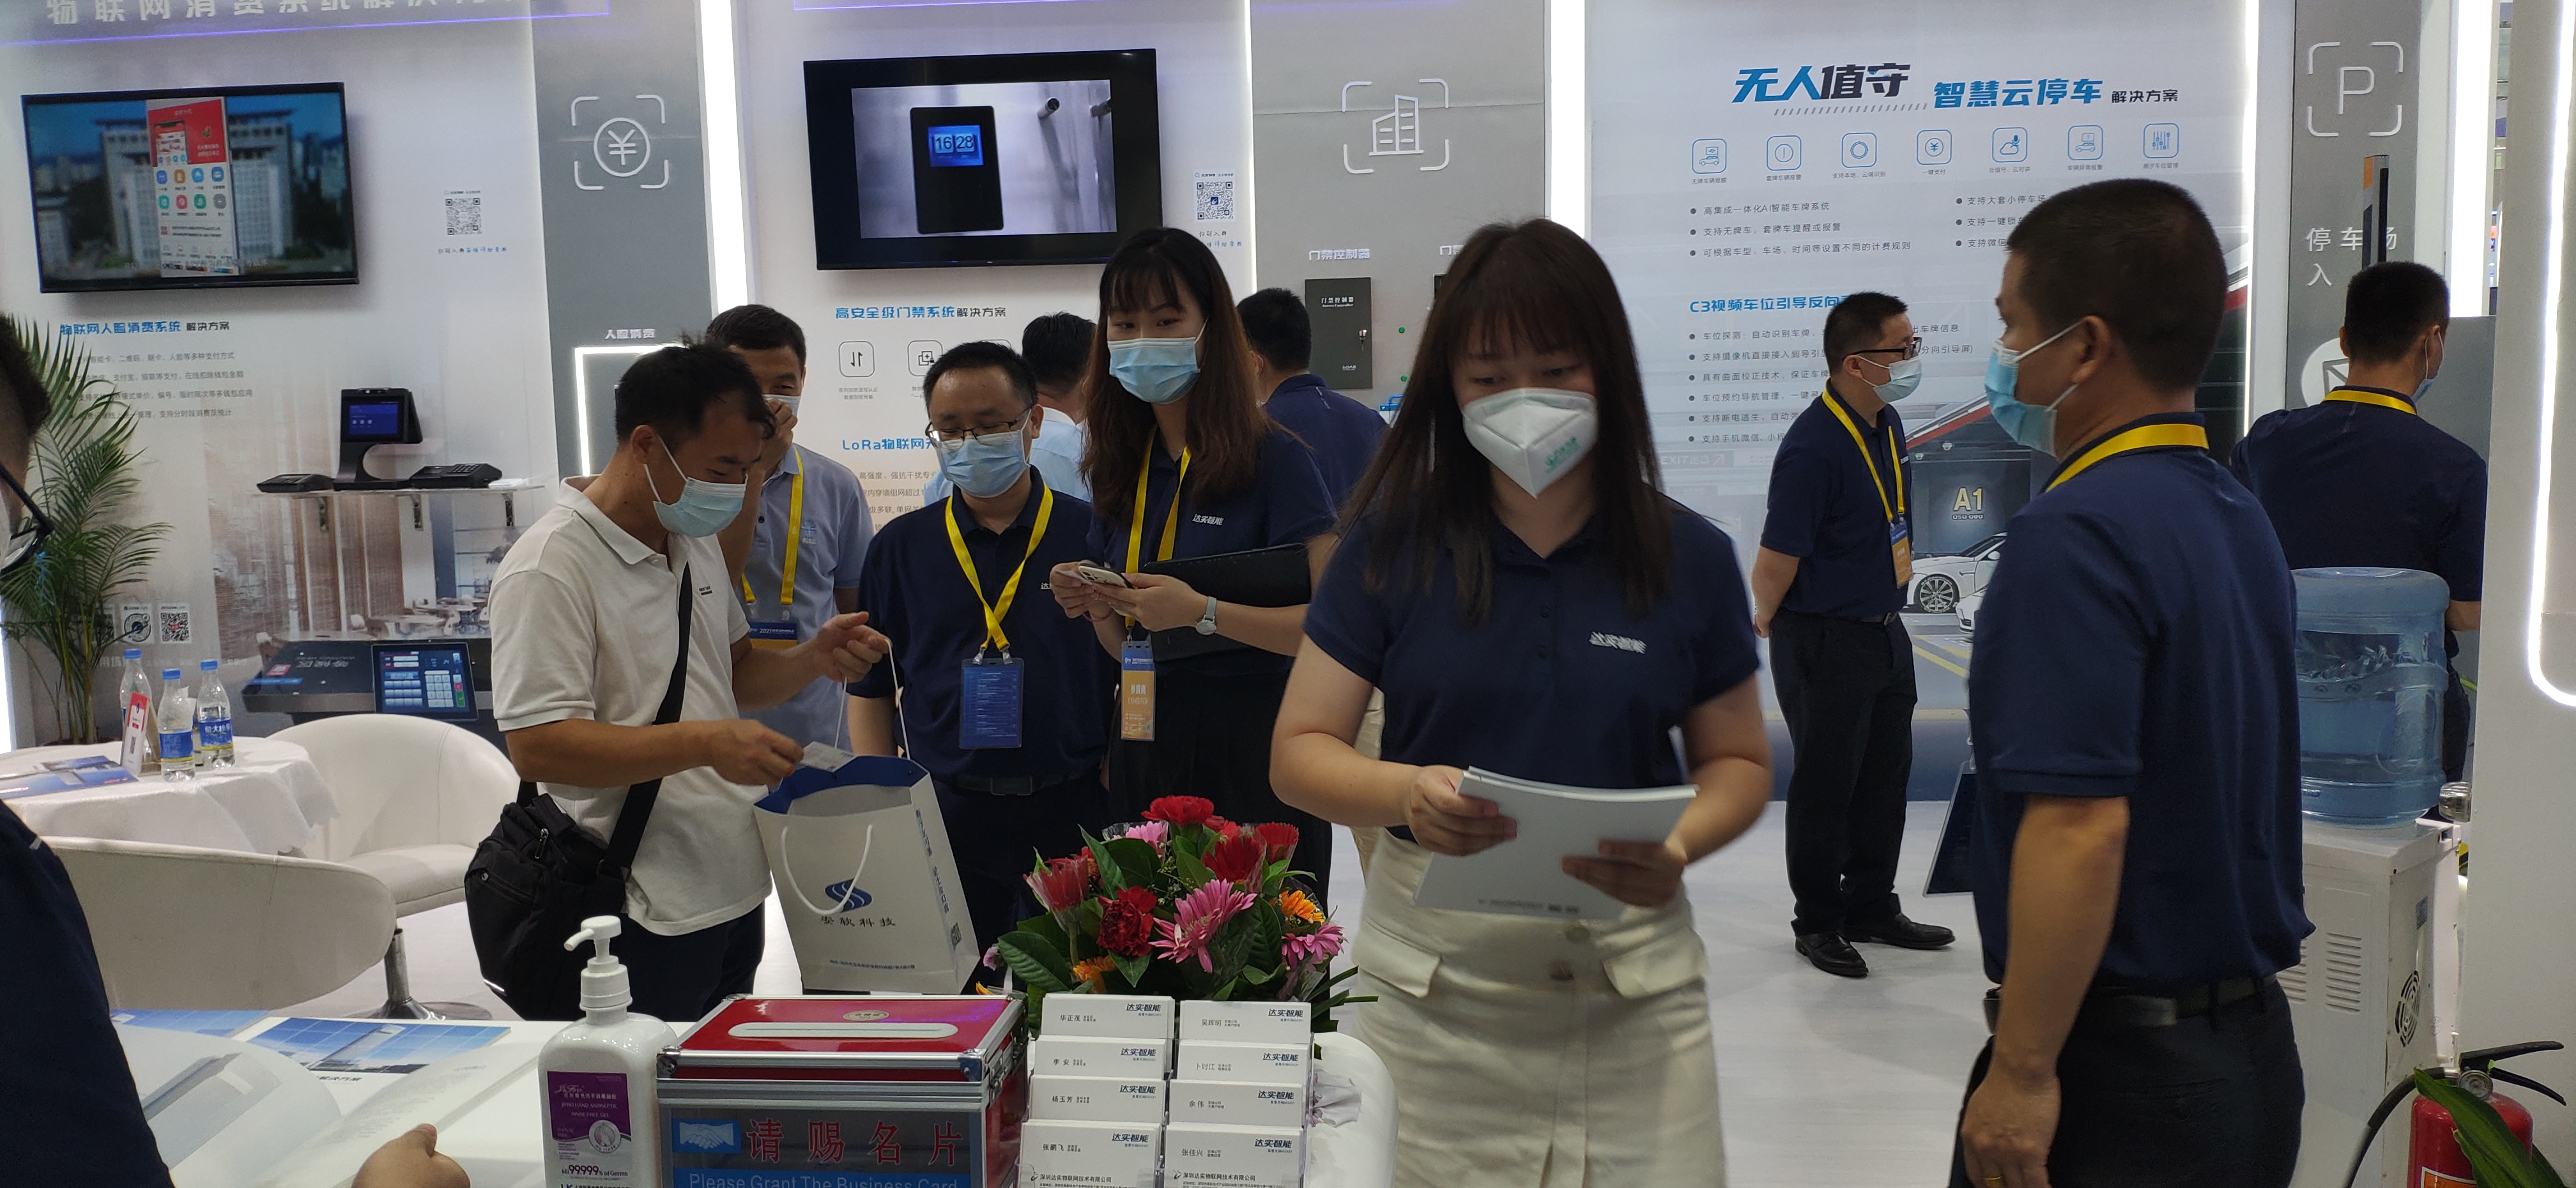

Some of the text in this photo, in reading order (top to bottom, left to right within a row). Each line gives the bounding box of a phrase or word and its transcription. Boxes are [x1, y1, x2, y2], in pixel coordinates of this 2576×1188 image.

[1732, 63, 1911, 103] 无人值守
[1934, 78, 2179, 109] 智慧云停车 解决方案
[935, 135, 974, 150] 16 28
[1703, 202, 1830, 216] 高集成一体化AI智能车牌系统
[1309, 248, 1370, 261] 门禁控制器
[2306, 263, 2333, 287] 入
[836, 306, 1007, 319] 高安全级门禁系统 解决方案
[186, 321, 231, 331] 解决方案
[605, 329, 656, 340] 人脸消费
[1953, 487, 1983, 512] A1
[1192, 513, 1224, 526] 达实智能
[1126, 1003, 1162, 1012] 达实智能
[1268, 1009, 1304, 1017] 达实智能
[1121, 1047, 1157, 1056] 达实智能
[1262, 1053, 1299, 1062] 达实智能
[1119, 1085, 1156, 1093] 达实智能
[1257, 1090, 1295, 1099] 达实智能
[746, 1118, 963, 1167] 请赐名片
[1112, 1133, 1149, 1143] 达实智能
[1254, 1138, 1292, 1148] 达实智能
[1182, 1148, 1203, 1157] 张佳兴
[689, 1173, 958, 1188] Please Grant The Business Card
[1039, 1174, 1112, 1183] 深圳达实物联网技术有限公司
[1183, 1172, 1255, 1182] 深圳达实物联网技术有限公司
